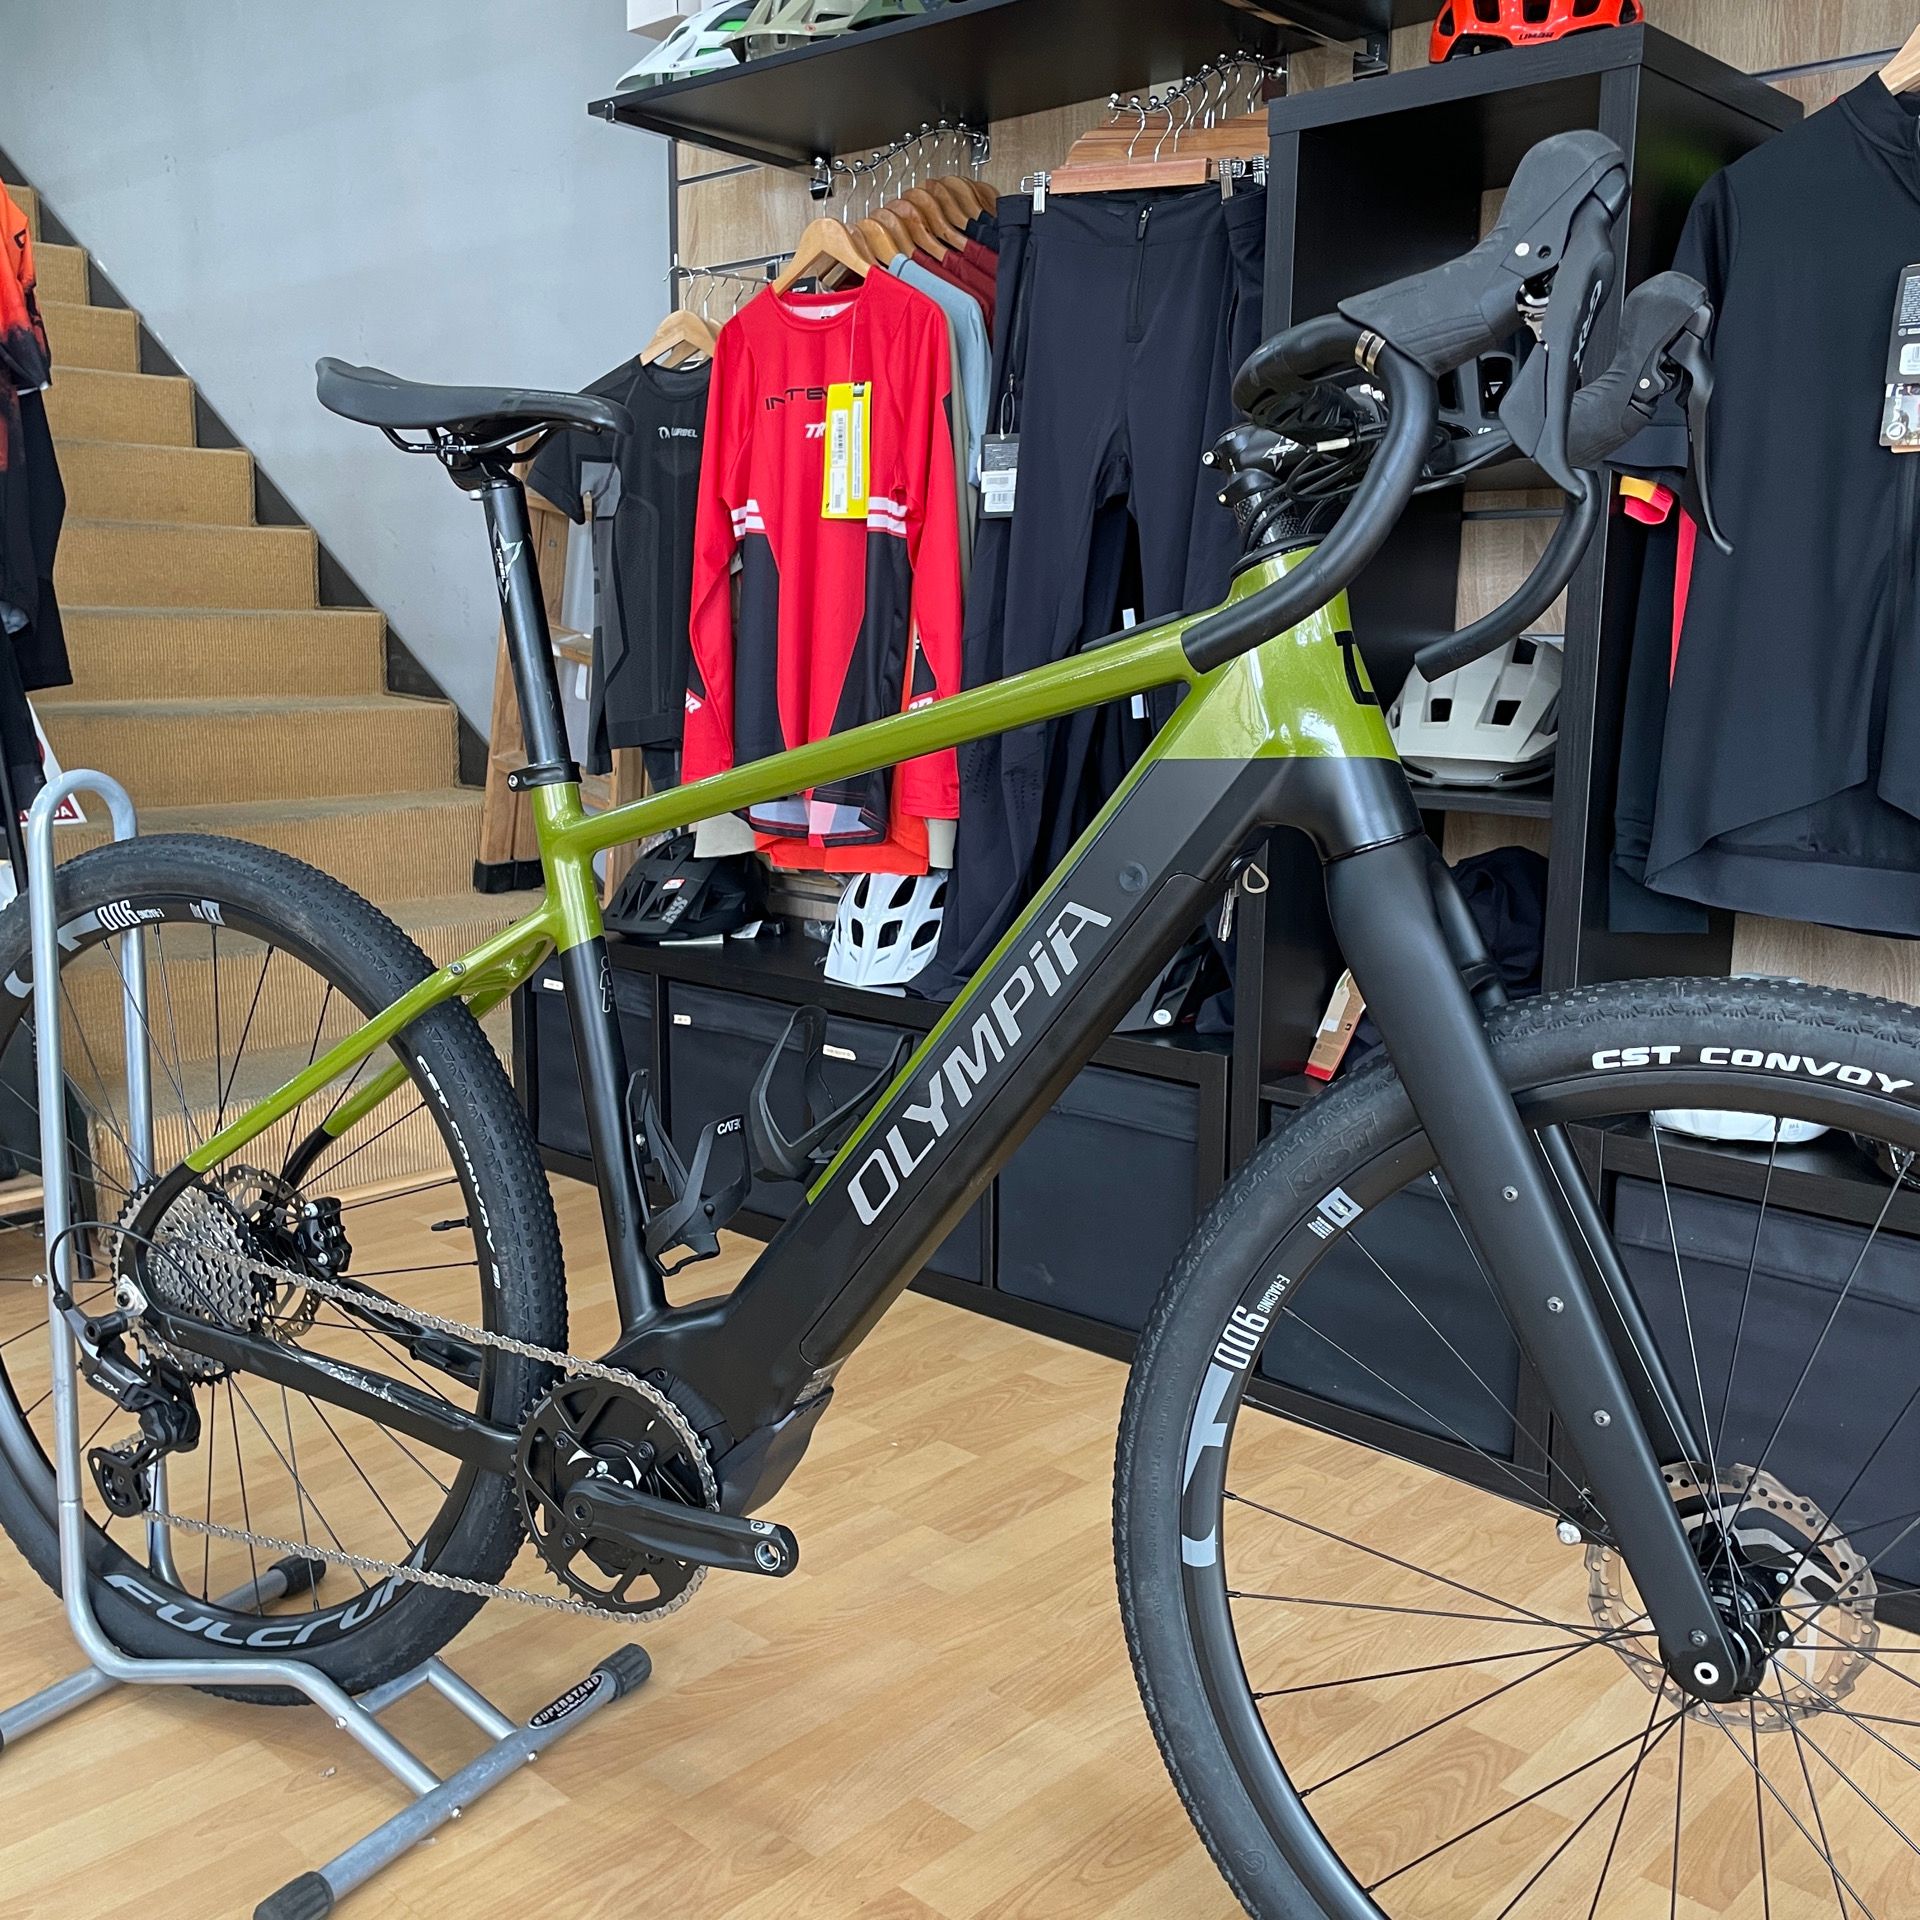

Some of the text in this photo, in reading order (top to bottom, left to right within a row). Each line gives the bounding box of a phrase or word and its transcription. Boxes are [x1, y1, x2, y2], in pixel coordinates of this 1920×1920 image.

[765, 387, 828, 411] INTE
[1592, 1045, 1914, 1093] CST CONVOY
[416, 1055, 450, 1109] CST
[451, 1120, 496, 1254] CONVOY
[1213, 1273, 1291, 1370] E-RACING 900
[533, 1676, 599, 1725] SUPERSTAND
